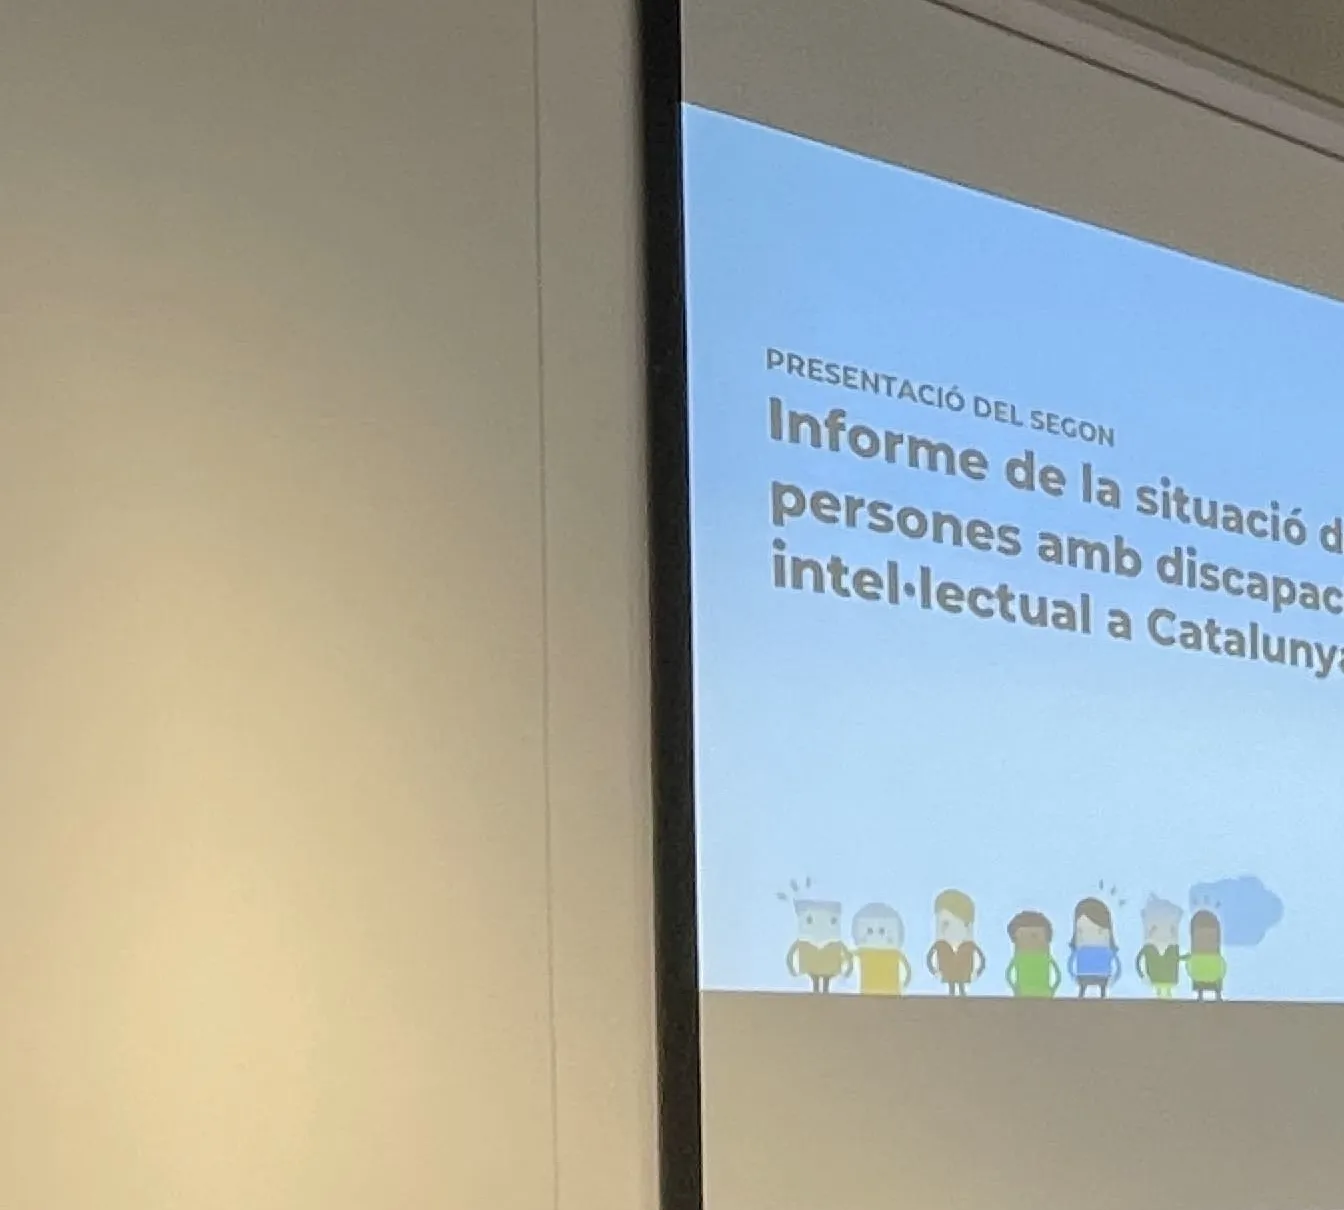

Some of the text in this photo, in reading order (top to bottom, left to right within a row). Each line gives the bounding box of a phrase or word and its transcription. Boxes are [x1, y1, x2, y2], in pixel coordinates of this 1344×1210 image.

[766, 347, 1115, 447] PRESENTACIÓ DEL SEGON
[768, 396, 989, 481] Informe
[1005, 449, 1066, 497] de
[1082, 462, 1120, 509] la
[1136, 476, 1307, 546] situació
[771, 481, 1021, 556] persones
[1038, 533, 1142, 578] amb
[772, 537, 1091, 635] intel·lectual
[1107, 608, 1132, 641] a
